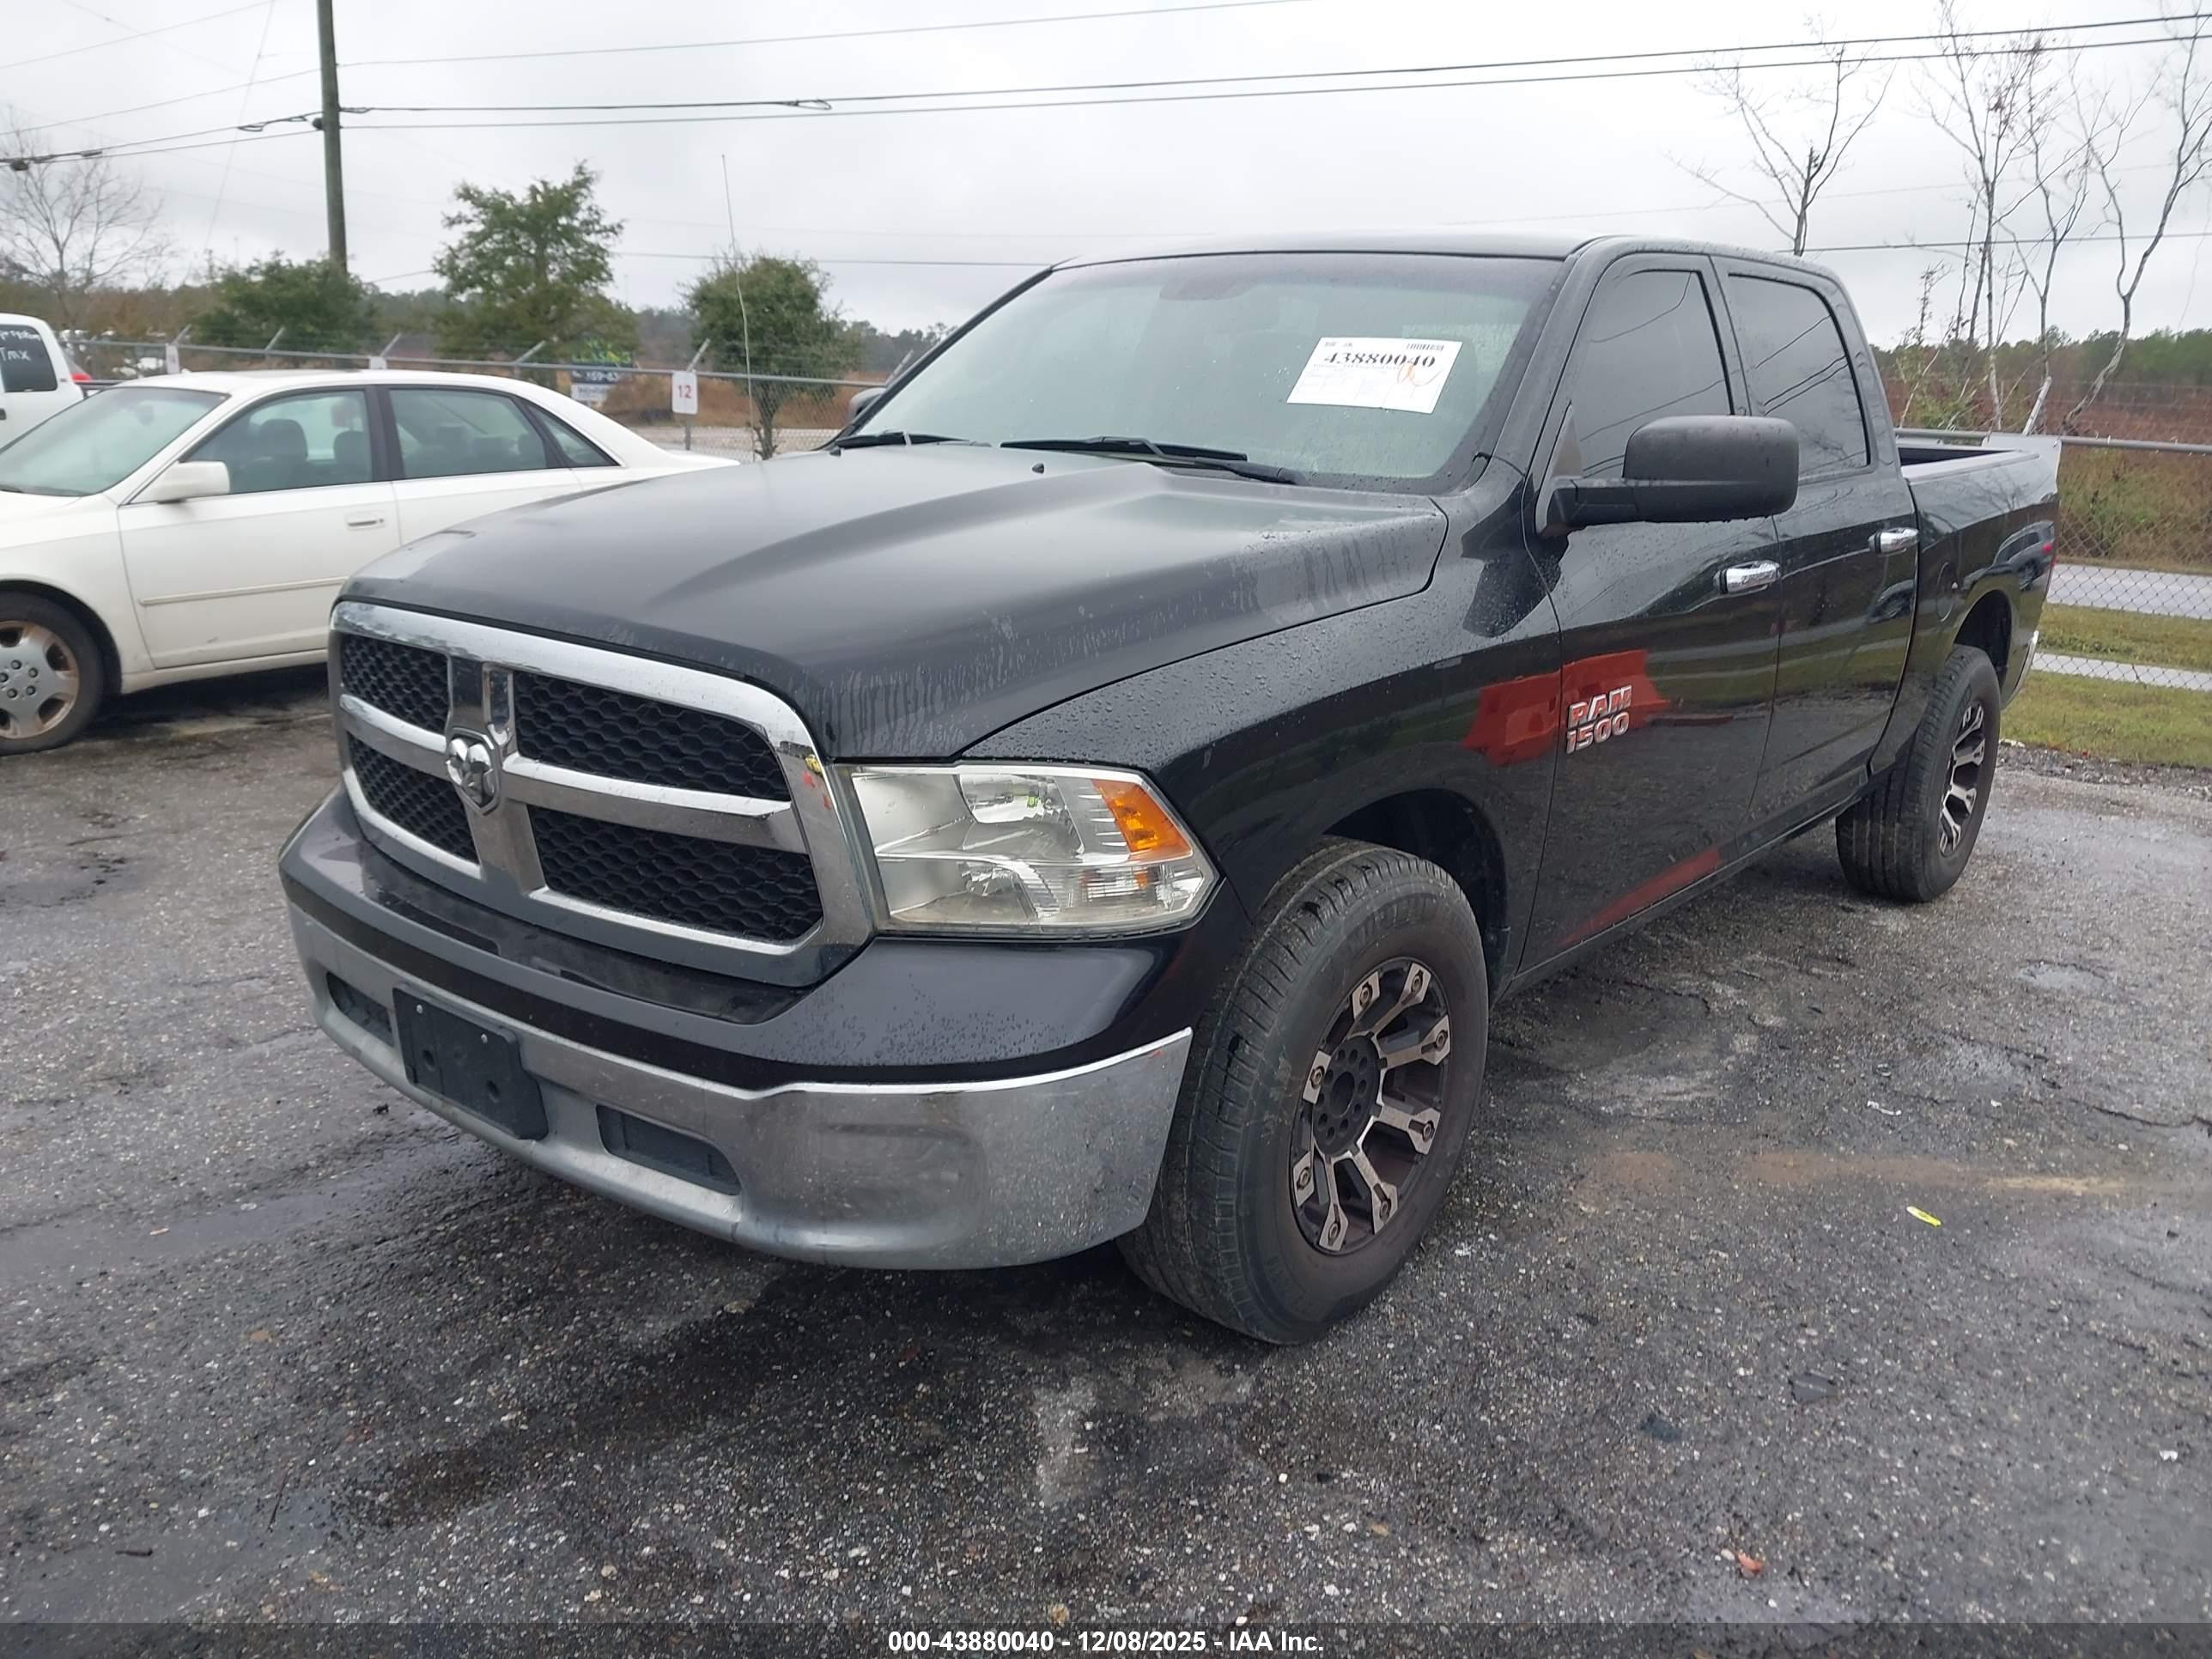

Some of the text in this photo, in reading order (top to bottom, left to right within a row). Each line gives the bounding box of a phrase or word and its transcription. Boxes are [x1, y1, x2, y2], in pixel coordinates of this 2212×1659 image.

[1323, 352, 1436, 368] 43880040
[678, 385, 691, 399] 12
[1568, 684, 1632, 728] RAM
[1565, 711, 1630, 755] 1500
